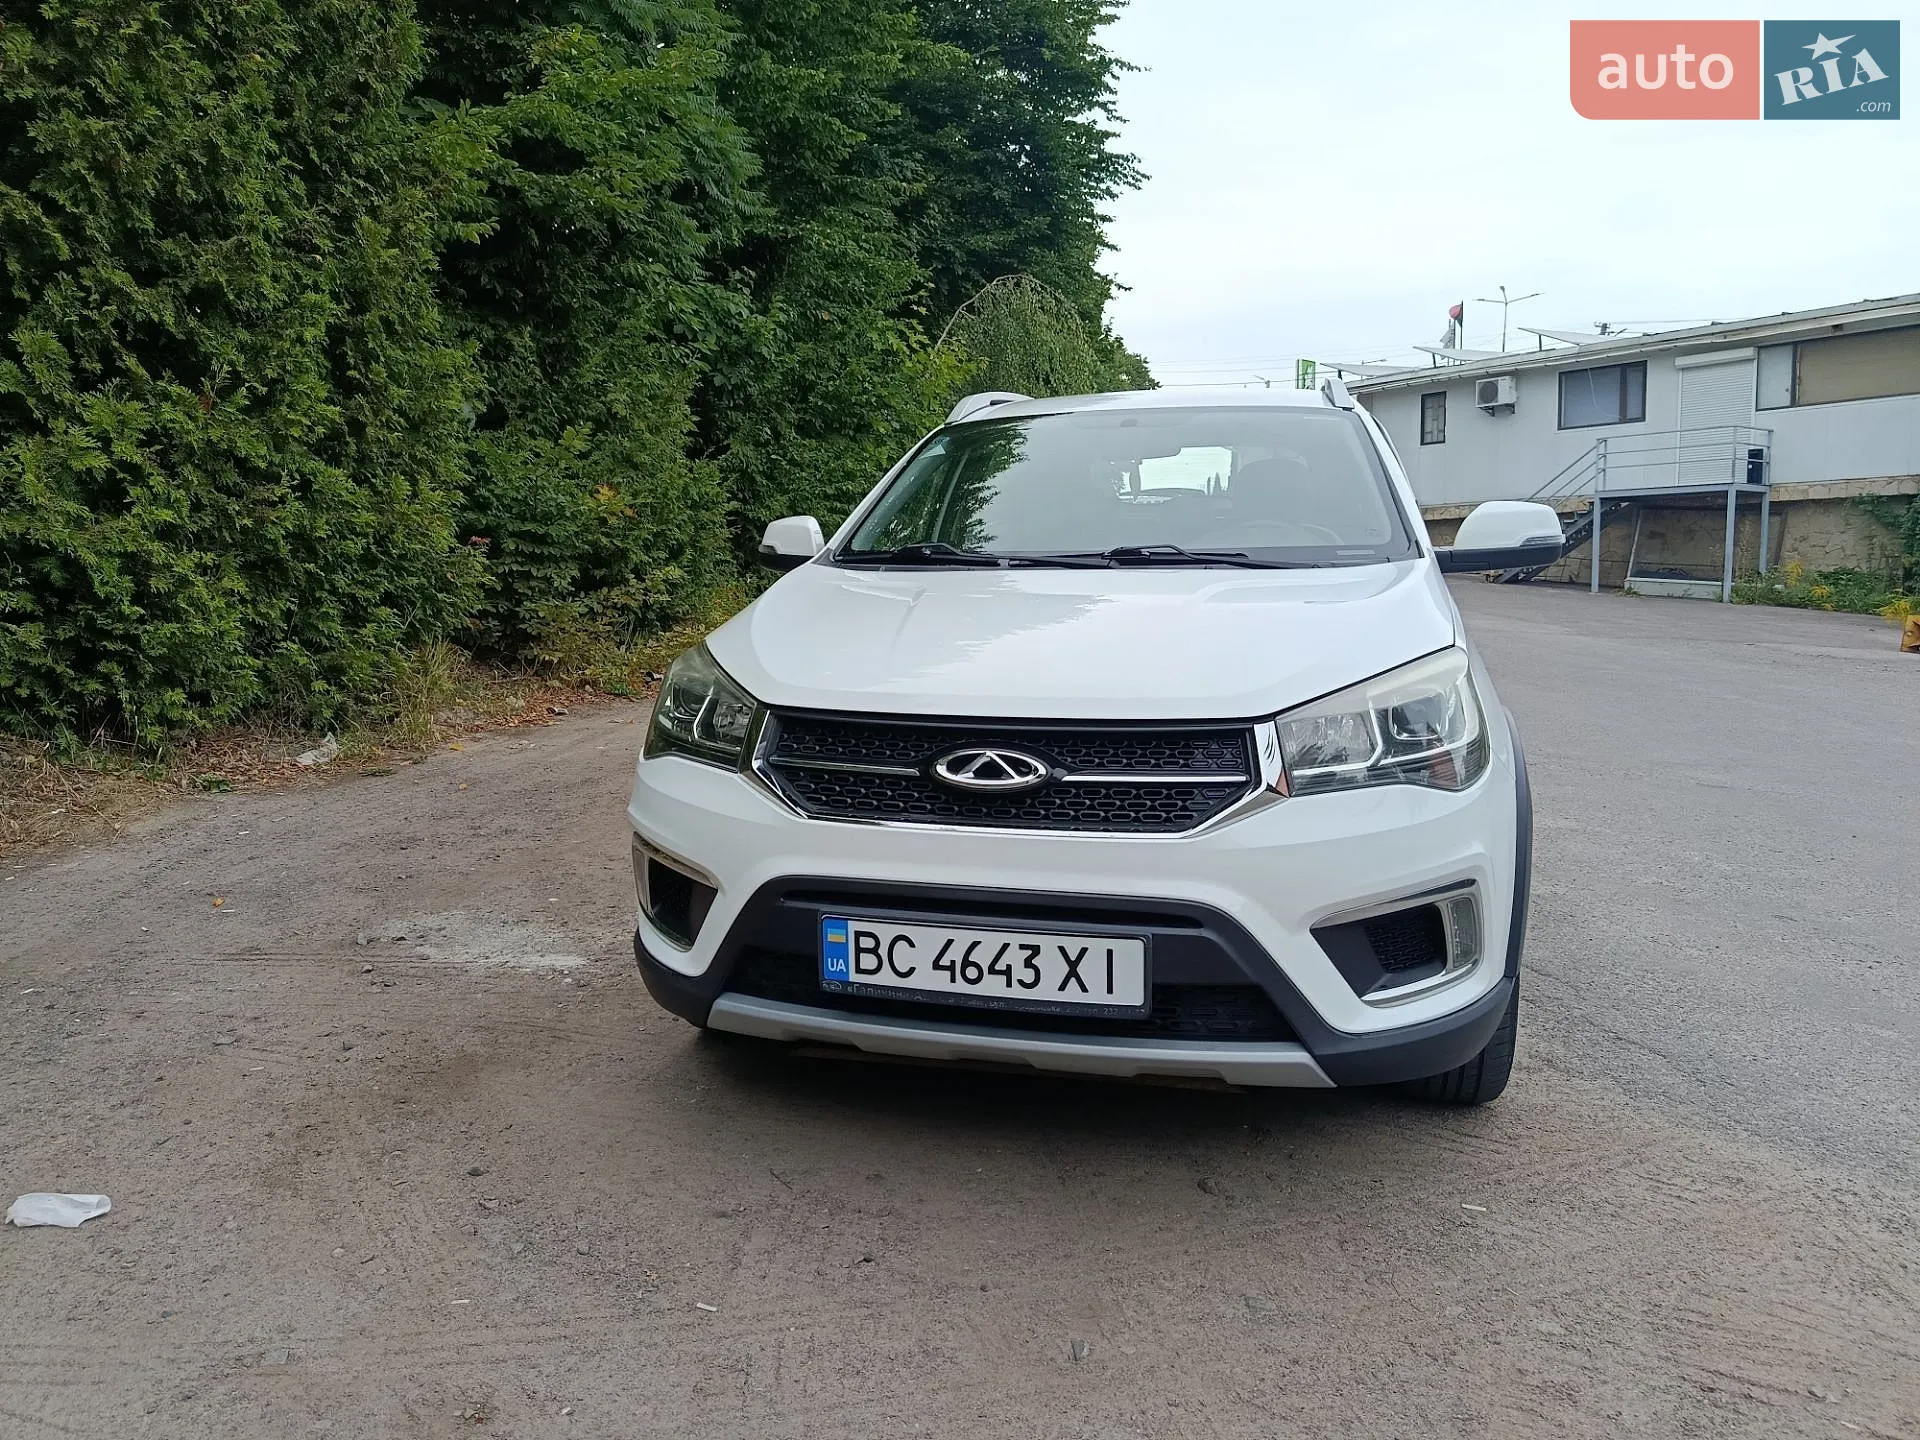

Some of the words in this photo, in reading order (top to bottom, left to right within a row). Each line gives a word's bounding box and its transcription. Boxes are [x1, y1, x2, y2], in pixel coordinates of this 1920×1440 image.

[827, 957, 847, 973] UA
[853, 930, 917, 979] BC
[931, 938, 1042, 990] 4643
[1056, 945, 1114, 995] XI
